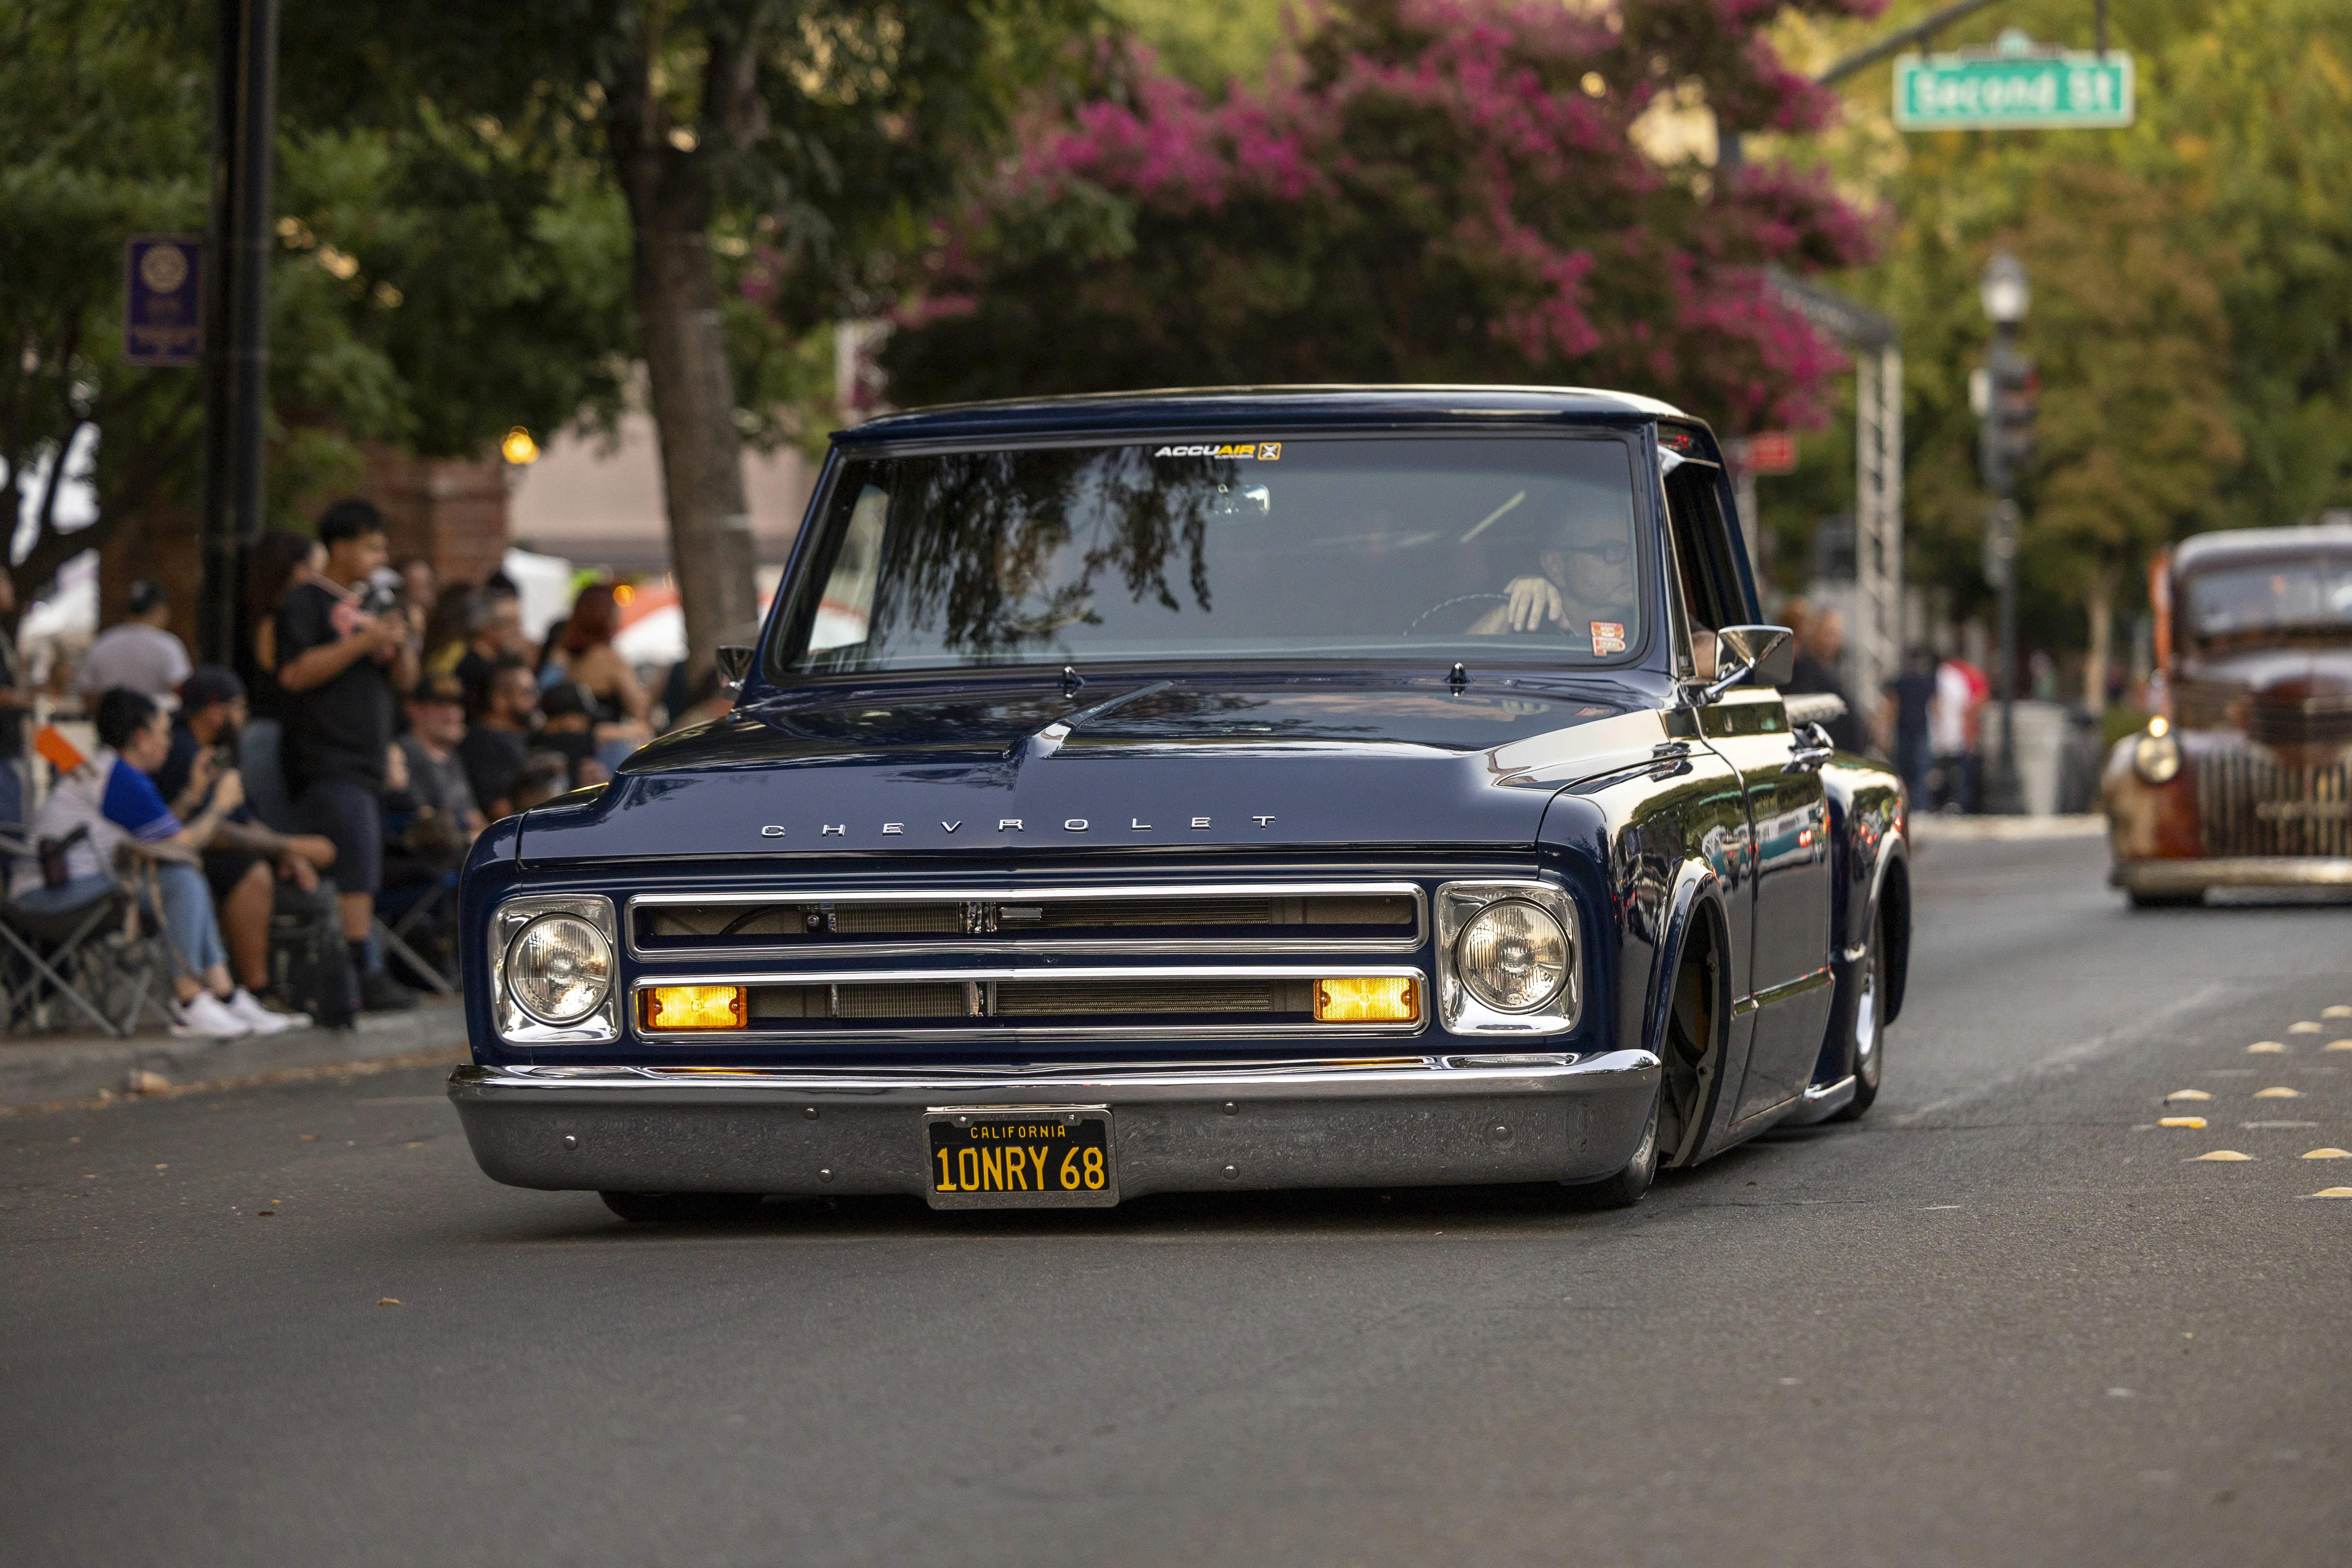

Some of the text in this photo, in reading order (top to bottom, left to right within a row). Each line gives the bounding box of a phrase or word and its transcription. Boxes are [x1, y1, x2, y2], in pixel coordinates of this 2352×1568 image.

[1914, 70, 2111, 115] Second St
[1154, 445, 1255, 457] ACCUAIR
[762, 816, 1276, 838] CHEVROLET
[971, 1125, 1065, 1138] CALIFORNIA
[1060, 1146, 1105, 1190] 68
